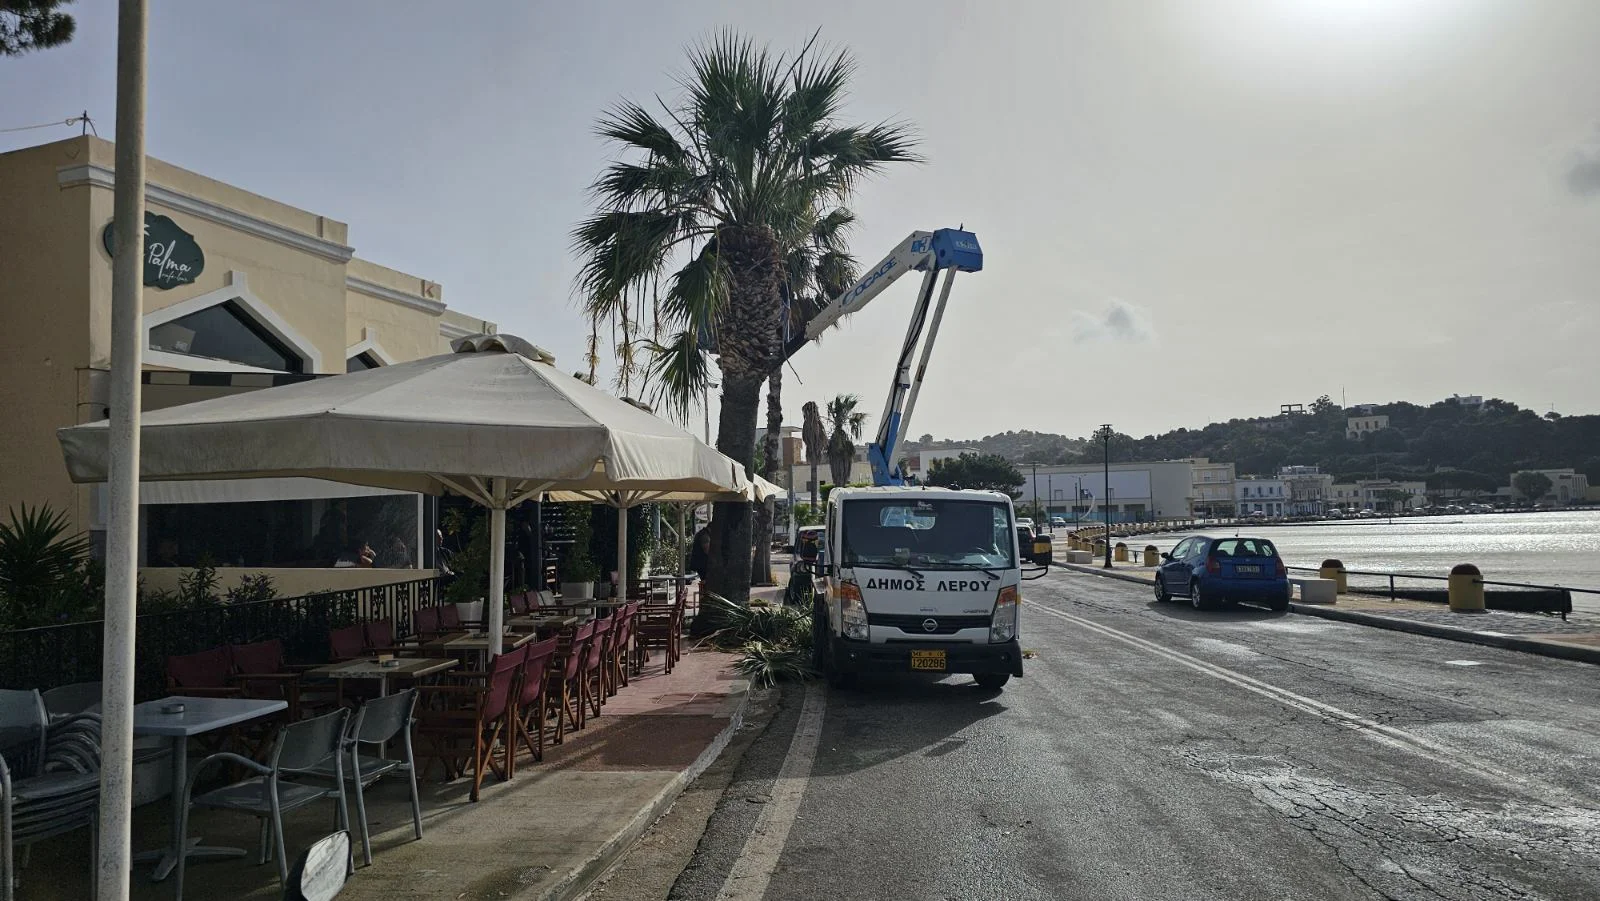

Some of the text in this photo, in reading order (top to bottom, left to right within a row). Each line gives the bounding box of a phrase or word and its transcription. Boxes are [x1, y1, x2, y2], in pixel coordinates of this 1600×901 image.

[149, 240, 191, 279] Palma
[866, 578, 991, 592] ΔΗΜΟΣ ΛΕΡΟΥ
[913, 658, 945, 669] 120286
